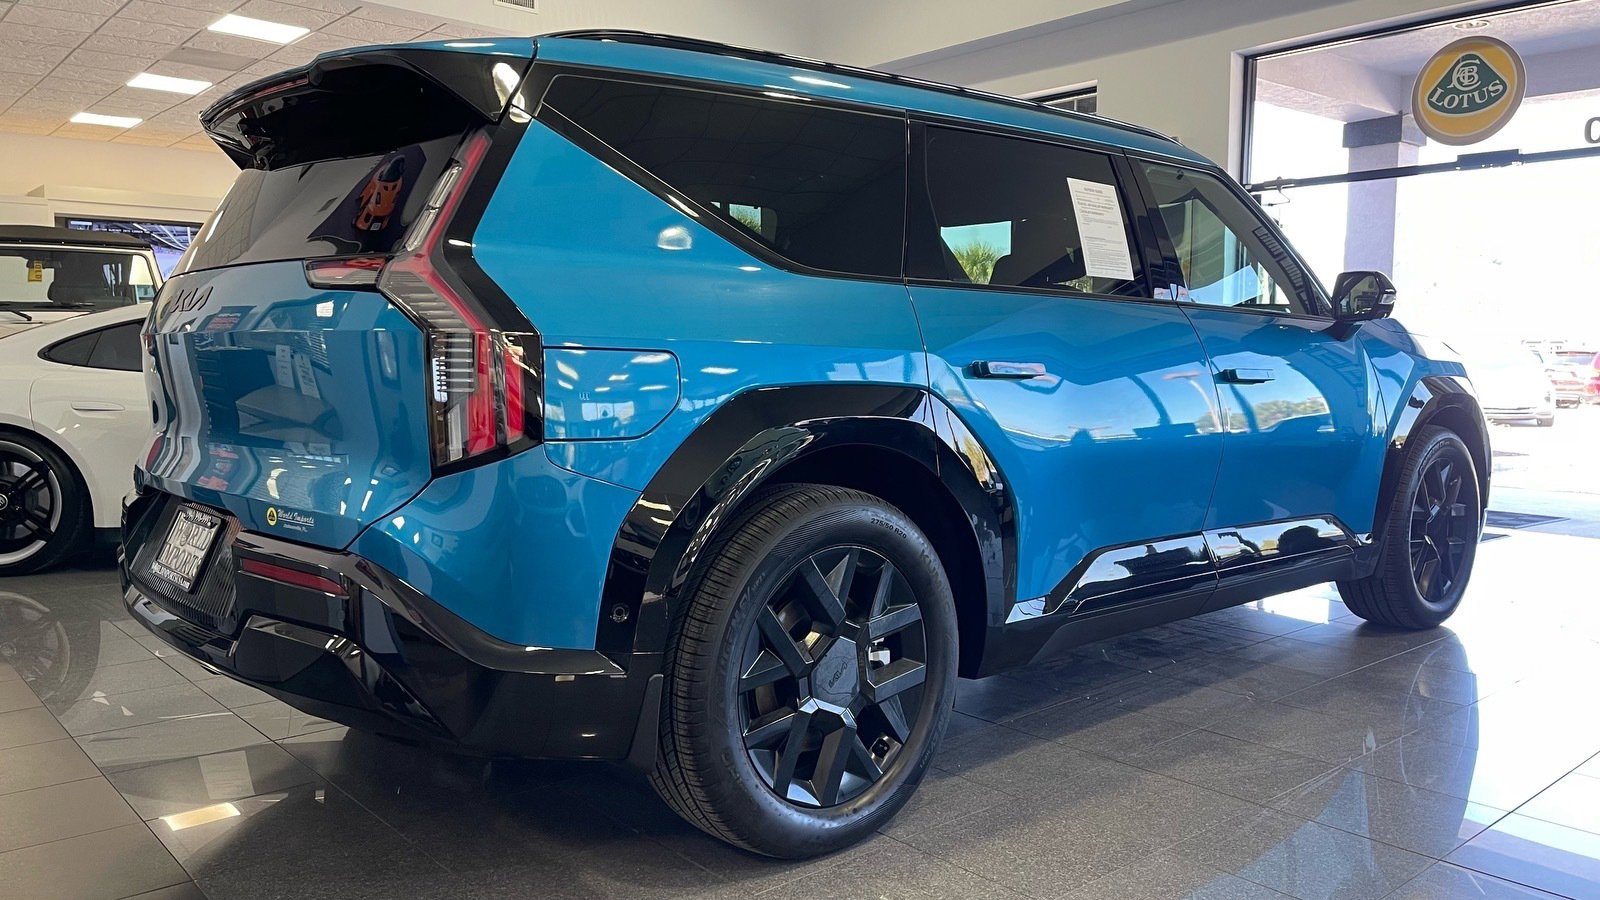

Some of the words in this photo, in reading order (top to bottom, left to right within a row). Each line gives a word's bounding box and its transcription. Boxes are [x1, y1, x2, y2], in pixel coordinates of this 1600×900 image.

[1429, 79, 1504, 109] LOTUS
[870, 517, 894, 531] 275/50
[894, 527, 907, 539] R20
